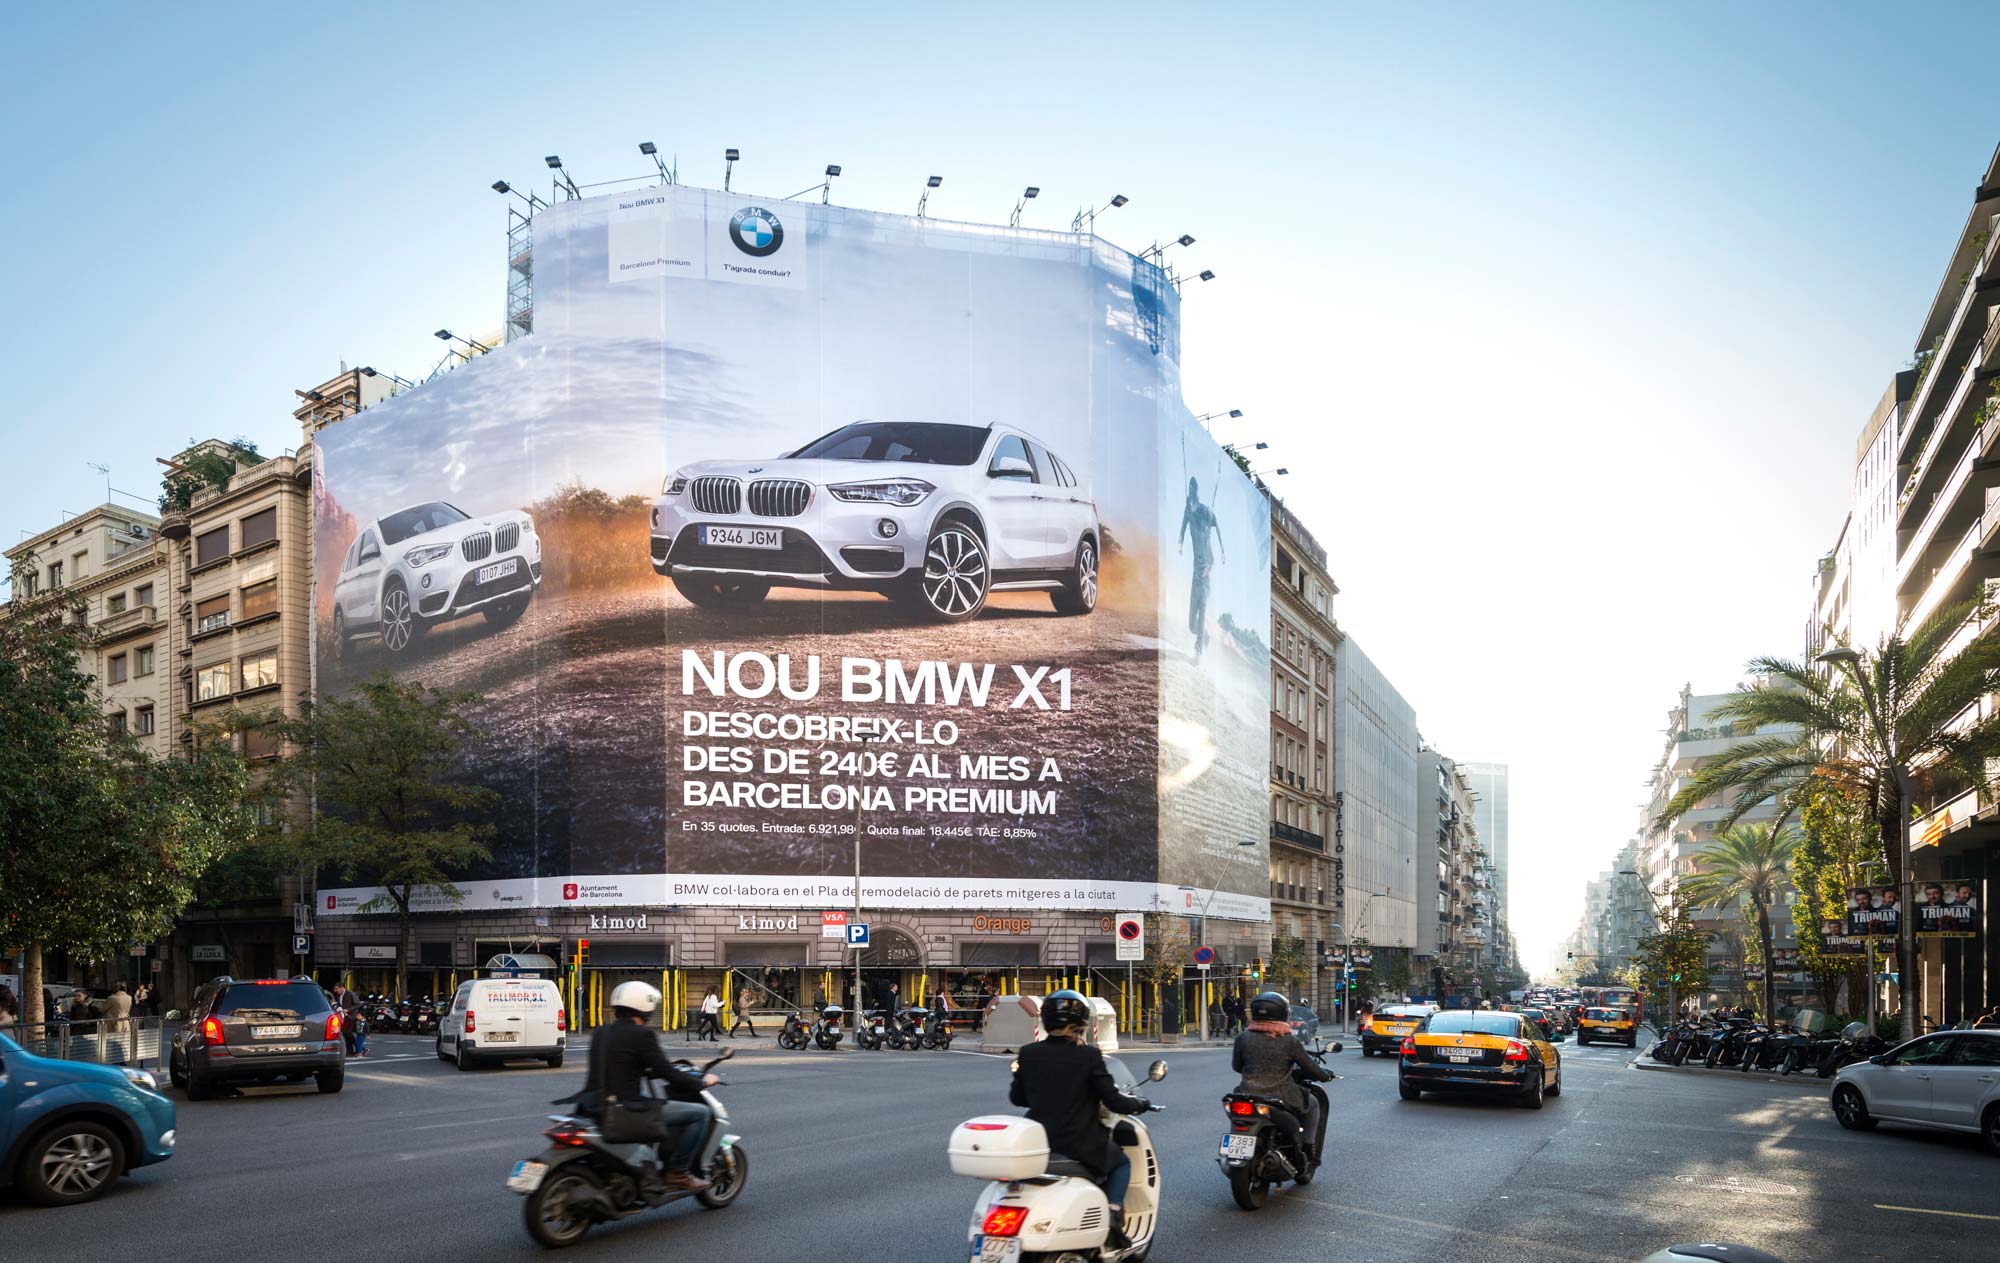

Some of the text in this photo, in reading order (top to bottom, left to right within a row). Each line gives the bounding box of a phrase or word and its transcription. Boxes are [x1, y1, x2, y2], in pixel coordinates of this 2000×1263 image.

[619, 197, 665, 210] Nou BMW X1
[620, 258, 691, 271] Barcelona Premium
[723, 264, 791, 278] T'agrada conduir?
[711, 529, 777, 545] 9346 JGM
[482, 560, 515, 581] 0107 JHH
[682, 650, 1072, 711] NOU BMW X1
[683, 711, 959, 746] DESCOBREIX-LO
[683, 746, 1063, 782] DES DE 240€ AL MES A
[683, 781, 1057, 815] BARCELONA PREMIUM
[682, 821, 698, 831] En
[701, 822, 715, 831] 35
[719, 822, 759, 833] quotes.
[762, 823, 805, 833] Entrada:
[867, 825, 899, 836] Quota
[902, 826, 926, 836] final:
[978, 827, 1000, 837] TAE:
[1003, 828, 1037, 838] 8,85%
[1335, 792, 1344, 853] EDIFICIO
[1335, 858, 1344, 896] APOLO
[580, 885, 618, 893] Ajuntament
[674, 884, 1116, 901] BMW col·labora en el Pla de remodelació de parets mitgeres a la ciutat
[1853, 910, 1896, 923] TRUMAN
[1921, 907, 1971, 919] TRUMAN
[590, 914, 648, 930] kimod
[739, 914, 798, 930] kimod
[974, 914, 1031, 934] Orange
[851, 925, 865, 942] P
[297, 937, 306, 949] P
[1442, 1048, 1463, 1056] 3400
[1230, 1136, 1255, 1147] 7383
[982, 1239, 1017, 1253] 2775
